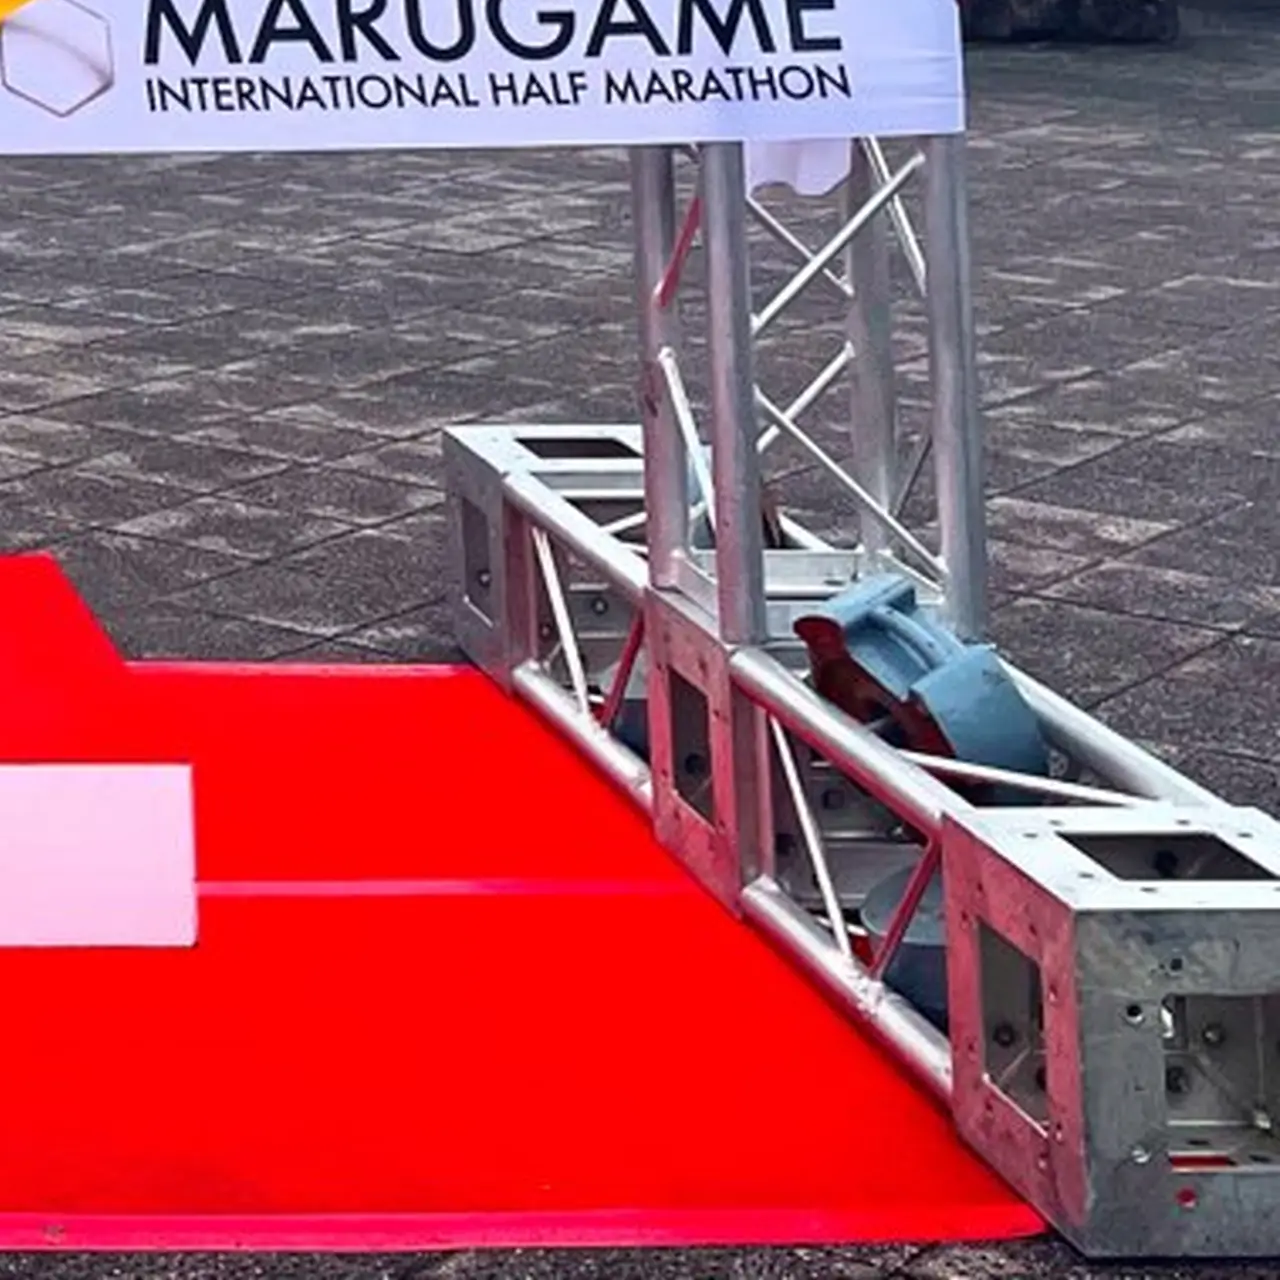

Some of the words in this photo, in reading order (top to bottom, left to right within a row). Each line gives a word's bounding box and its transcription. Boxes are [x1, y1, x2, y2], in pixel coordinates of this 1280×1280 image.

[146, 73, 480, 113] INTERNATIONAL
[489, 70, 588, 106] HALF
[605, 64, 851, 105] MARATHON
